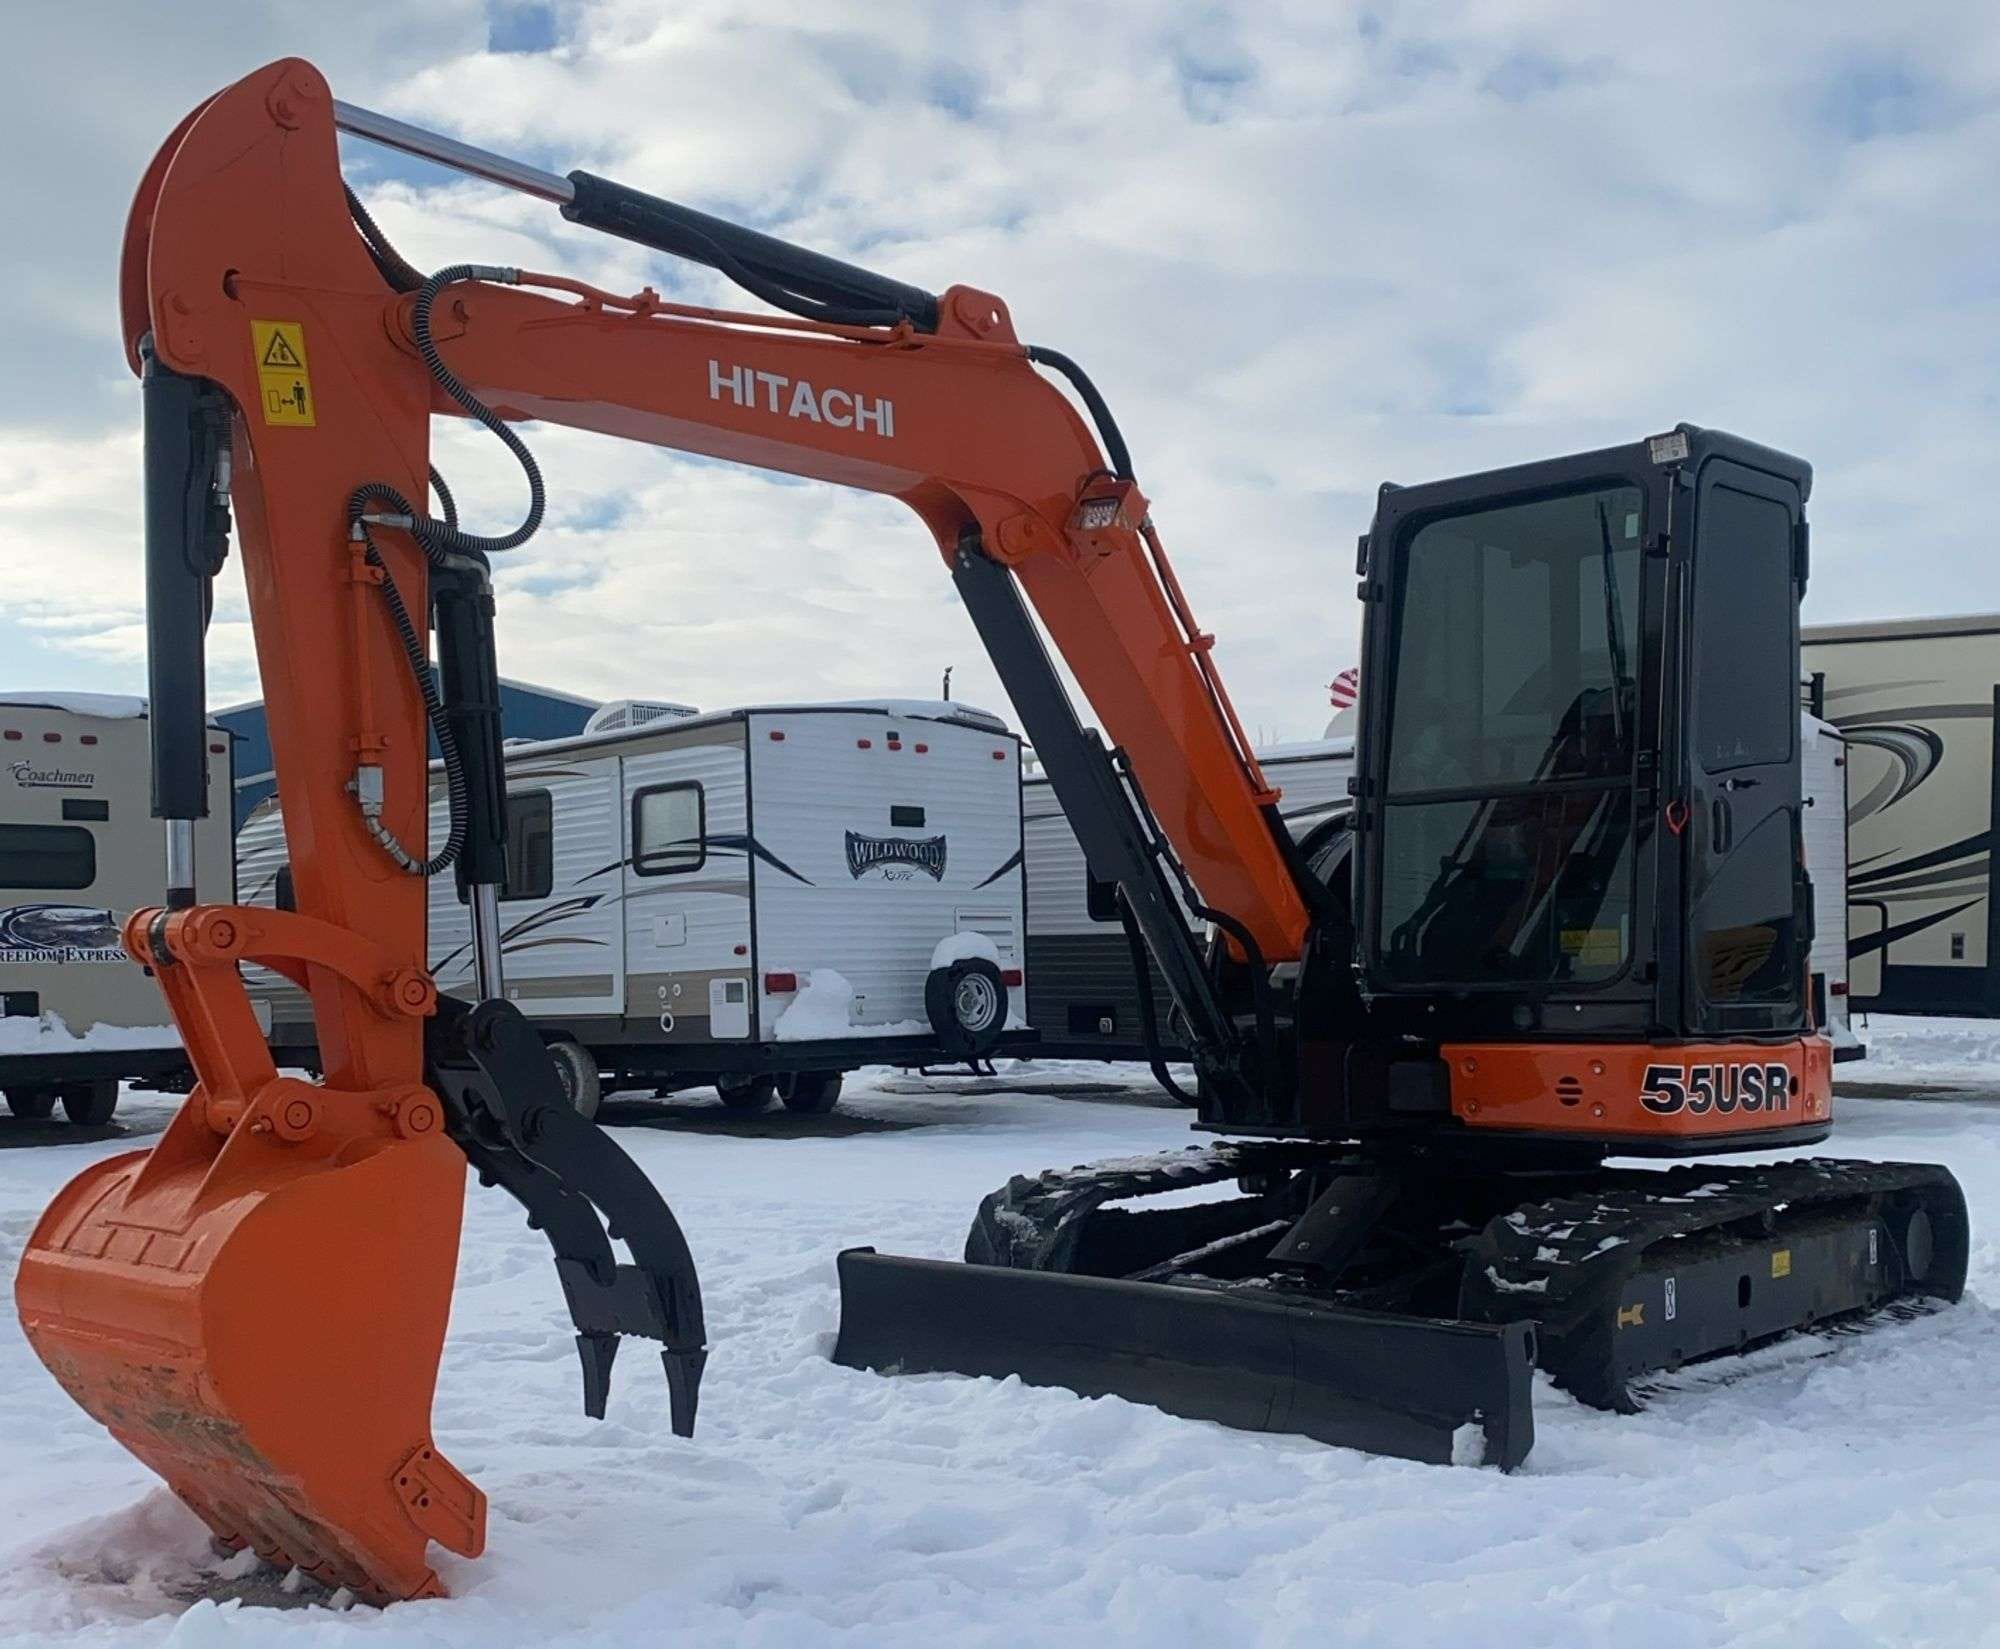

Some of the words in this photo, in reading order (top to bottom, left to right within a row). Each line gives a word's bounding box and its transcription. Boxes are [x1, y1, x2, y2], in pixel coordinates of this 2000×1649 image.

[708, 359, 895, 438] HITACHI
[15, 767, 95, 783] Coachmen
[853, 842, 940, 868] WILDWOOD
[65, 947, 128, 961] EXPRESS
[1639, 1063, 1790, 1115] 55USR
